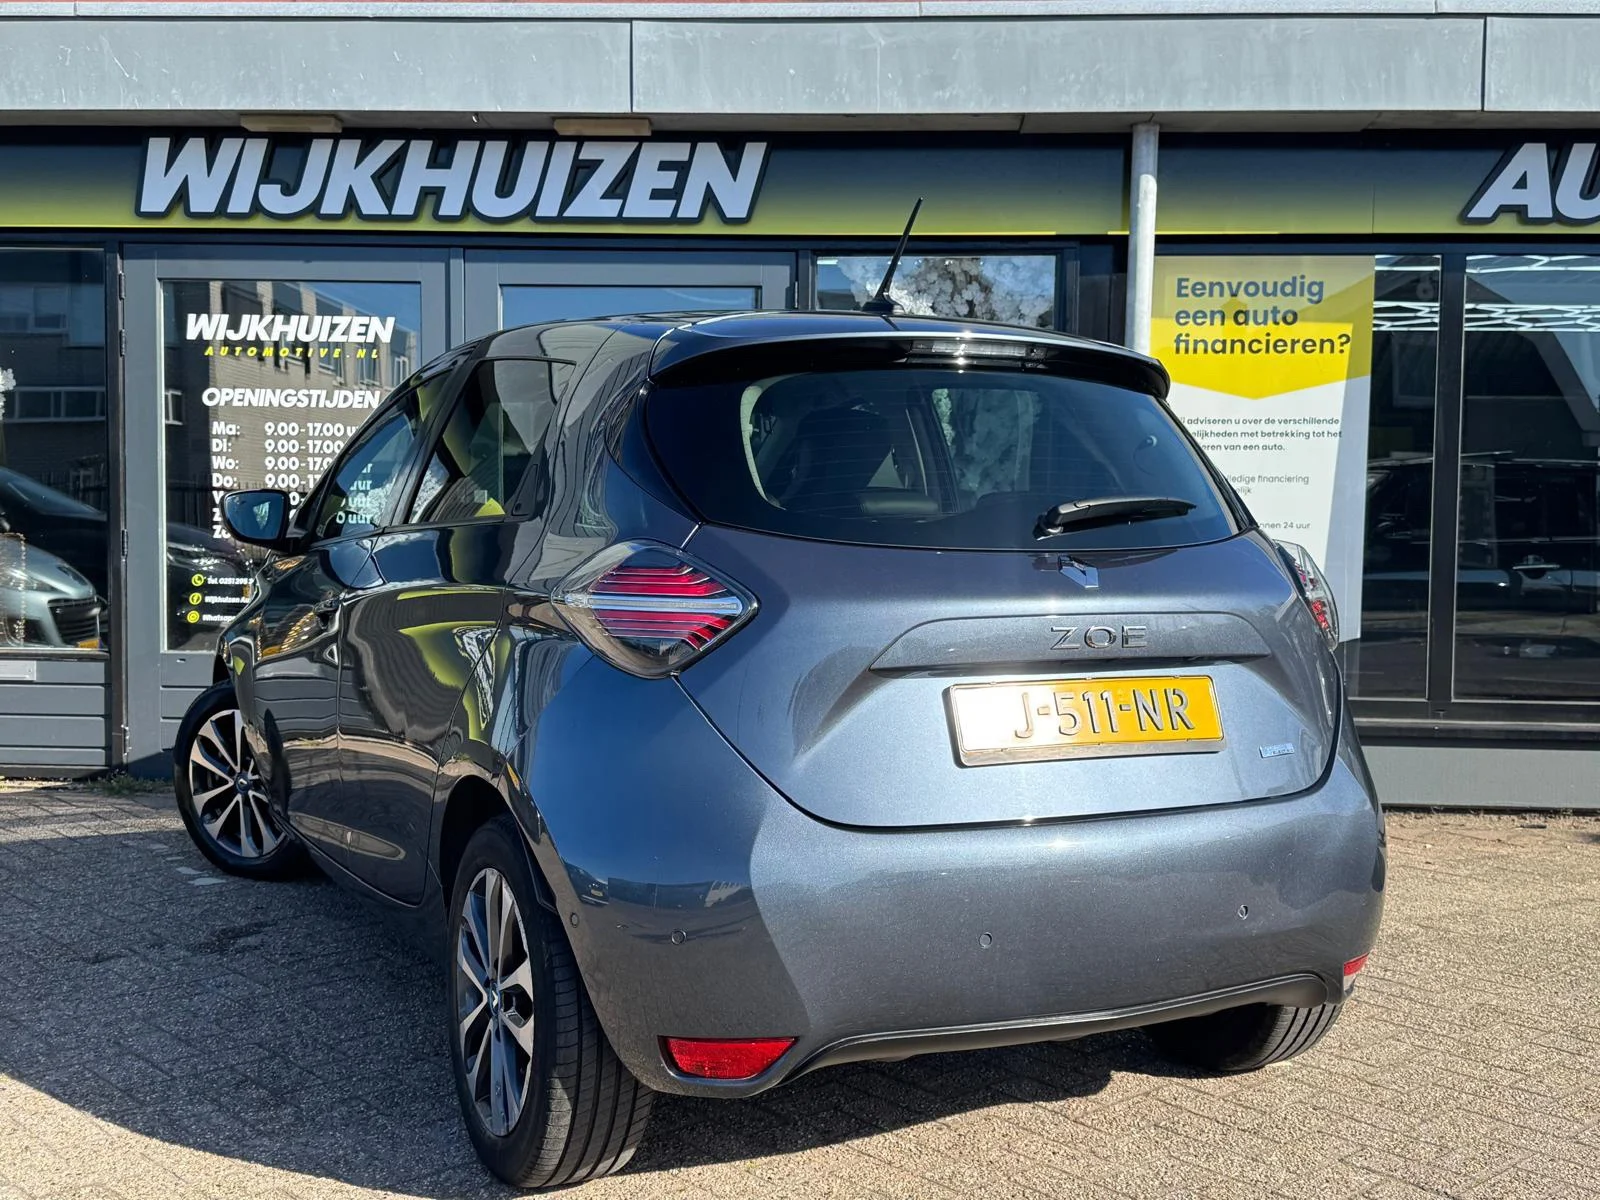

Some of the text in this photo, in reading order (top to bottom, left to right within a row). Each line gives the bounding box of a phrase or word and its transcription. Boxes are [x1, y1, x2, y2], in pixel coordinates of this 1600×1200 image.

[139, 137, 768, 219] WIJKHUIZEN
[1175, 276, 1325, 304] Eenvoudig
[1174, 306, 1299, 327] een auto
[186, 313, 396, 343] WIJKHUIZEN
[1174, 332, 1351, 356] financieren?
[204, 346, 379, 359] AUTOMOTIVE.NL
[202, 387, 381, 408] OPENINGSTIJDEN
[1187, 417, 1233, 425] adviseren
[1264, 416, 1276, 425] de
[1277, 416, 1340, 425] verschillende
[212, 421, 241, 436] Ma:
[1240, 430, 1259, 438] met
[1260, 429, 1311, 439] betrekking
[1312, 430, 1325, 438] tot
[1327, 429, 1342, 438] het
[212, 438, 233, 453] Di:
[1262, 443, 1286, 451] auto.
[212, 456, 240, 470] Wo:
[212, 473, 239, 488] Do:
[1257, 474, 1309, 485] financiering
[1283, 521, 1294, 529] 24
[1050, 625, 1149, 650] ZOE
[1013, 687, 1196, 739] J-511-NR
